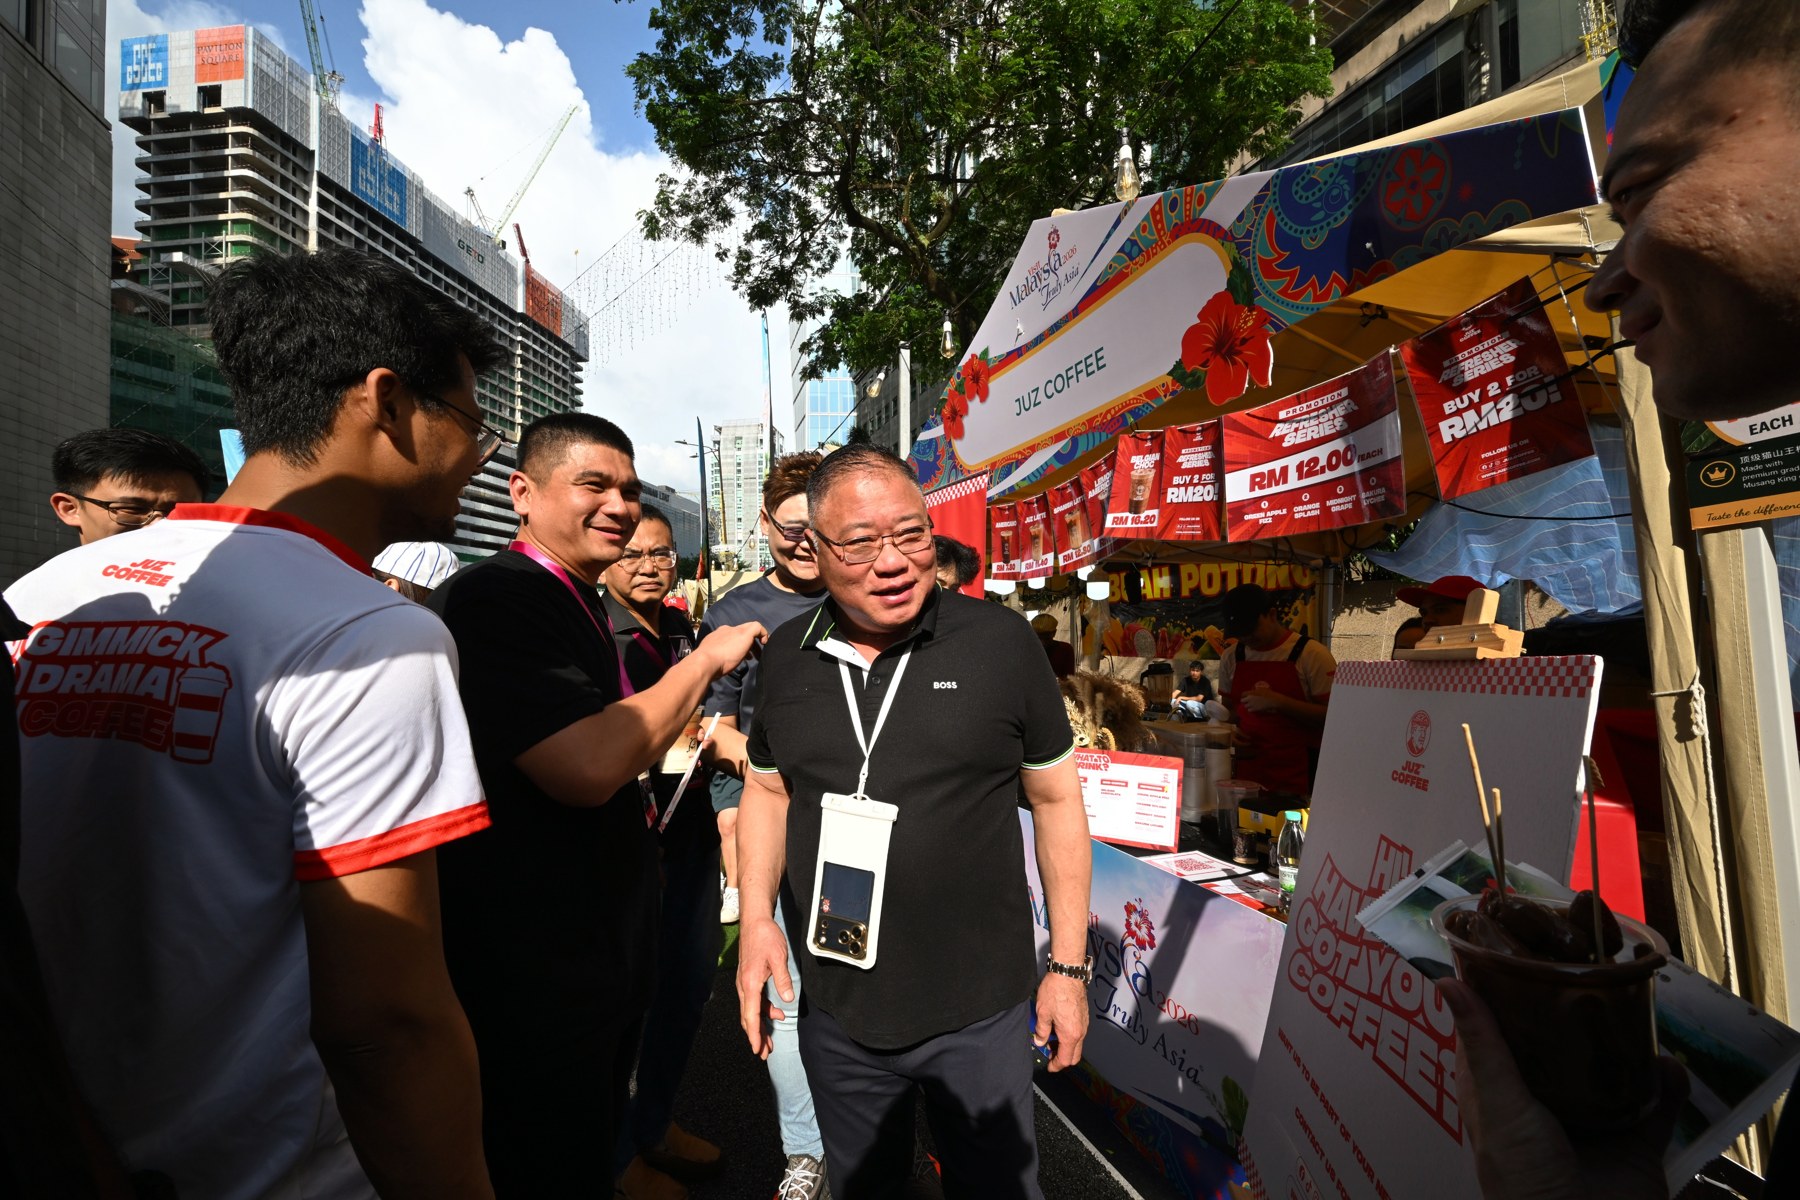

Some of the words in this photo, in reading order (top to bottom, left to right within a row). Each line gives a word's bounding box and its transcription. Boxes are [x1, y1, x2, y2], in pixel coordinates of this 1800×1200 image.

[197, 42, 243, 54] PAVILION
[201, 54, 240, 65] SQUARE
[457, 238, 485, 264] GETO
[1009, 250, 1063, 309] Malaysia
[1062, 246, 1077, 265] 2026
[1041, 280, 1063, 307] Truly
[1063, 266, 1079, 287] Asia
[1448, 335, 1504, 364] PROMOTION
[1438, 339, 1526, 383] REFRESHER
[1452, 353, 1516, 387] SERIES
[1014, 388, 1042, 417] JUZ
[1044, 347, 1108, 400] COFFEE
[1443, 388, 1481, 415] BUY
[1487, 381, 1501, 397] 2
[1505, 365, 1540, 387] FOR
[1285, 391, 1343, 416] PROMOTION
[1438, 375, 1562, 444] RM20!
[1269, 398, 1359, 439] REFRESHER
[1749, 414, 1794, 436] EACH
[1281, 417, 1349, 448] SERIES
[1130, 453, 1160, 464] BELGIAN
[1481, 445, 1508, 459] FOLLOW
[1133, 460, 1155, 469] CHOC
[1181, 460, 1210, 468] SERIES
[1741, 464, 1763, 473] Made
[1765, 460, 1783, 468] with
[1742, 469, 1778, 481] premium
[1780, 465, 1800, 475] grad
[1172, 475, 1191, 485] BUY
[1193, 474, 1199, 483] 2
[1201, 473, 1216, 481] FOR
[1249, 464, 1289, 492] RM
[1743, 478, 1775, 489] Musang
[1778, 475, 1797, 483] King
[1088, 479, 1111, 499] AMERIC
[1166, 483, 1219, 503] RM20!
[1361, 487, 1386, 498] SAKURA
[1293, 502, 1320, 513] ORANGE
[1326, 494, 1357, 507] MIDNIGHT
[1331, 502, 1353, 512] GRAPE
[1111, 516, 1128, 525] RM
[1244, 512, 1266, 520] GREEN
[1266, 508, 1287, 517] APPLE
[1294, 510, 1320, 519] SPLASH
[1707, 512, 1732, 522] Taste
[1734, 509, 1751, 518] the
[1753, 503, 1800, 515] differenc
[130, 559, 169, 571] JUZ
[1025, 562, 1034, 570] RM
[1063, 552, 1074, 563] RM
[102, 565, 174, 587] COFFEE
[26, 624, 216, 667] GIMMICK
[27, 662, 171, 700] DRAMA
[933, 681, 958, 690] BOSS
[24, 701, 175, 747] COFFEE
[1077, 762, 1110, 772] RINK?
[1097, 755, 1110, 764] TO
[1402, 760, 1422, 775] JUZ
[1391, 769, 1430, 792] COFFEE
[1296, 898, 1361, 982] GOT
[1156, 991, 1200, 1036] 2026
[1094, 974, 1149, 1045] Truly
[1153, 1032, 1201, 1086] Asia
[1279, 1027, 1293, 1054] WANT
[1293, 1052, 1301, 1068] US
[1302, 1063, 1311, 1081] TO
[1310, 1077, 1320, 1097] BE
[1320, 1092, 1340, 1126] PART
[1340, 1123, 1351, 1144] OF
[1352, 1141, 1375, 1184] YOUR
[1295, 1107, 1325, 1161] CONTACT
[1325, 1158, 1336, 1182] US
[1336, 1179, 1351, 1200] FO
